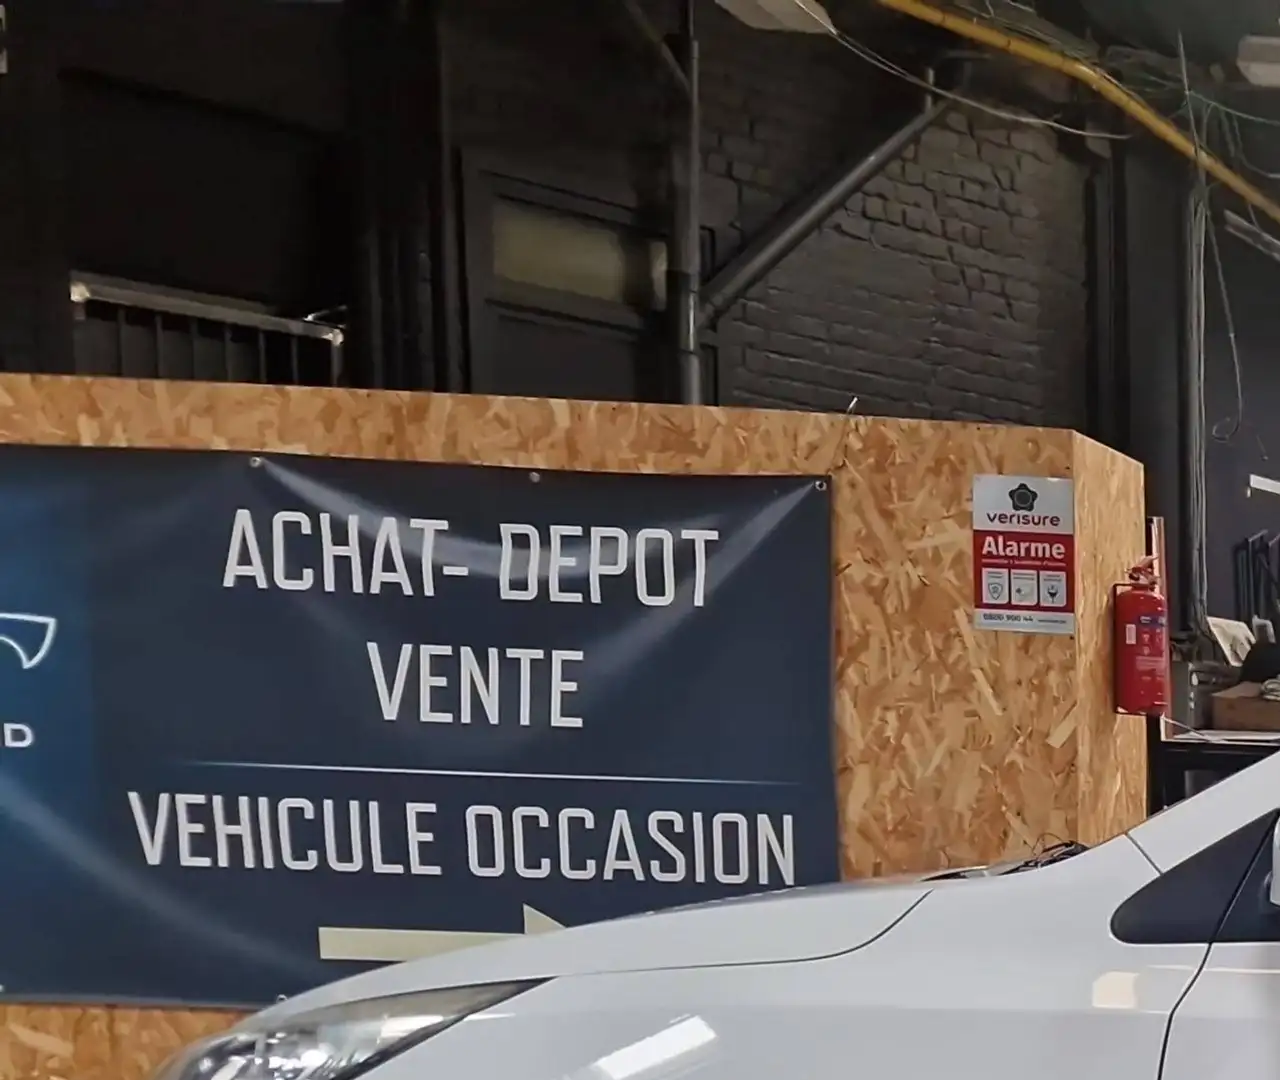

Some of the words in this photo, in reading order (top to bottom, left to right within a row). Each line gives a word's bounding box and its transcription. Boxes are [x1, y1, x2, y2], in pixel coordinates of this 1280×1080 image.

[222, 508, 470, 598] ACHAT-
[499, 523, 720, 607] DEPOT
[981, 535, 1066, 560] Alarme
[986, 511, 1061, 527] verisure
[367, 641, 585, 729] VENTE
[127, 791, 443, 876] VEHICULE
[466, 804, 796, 886] OCCASION
